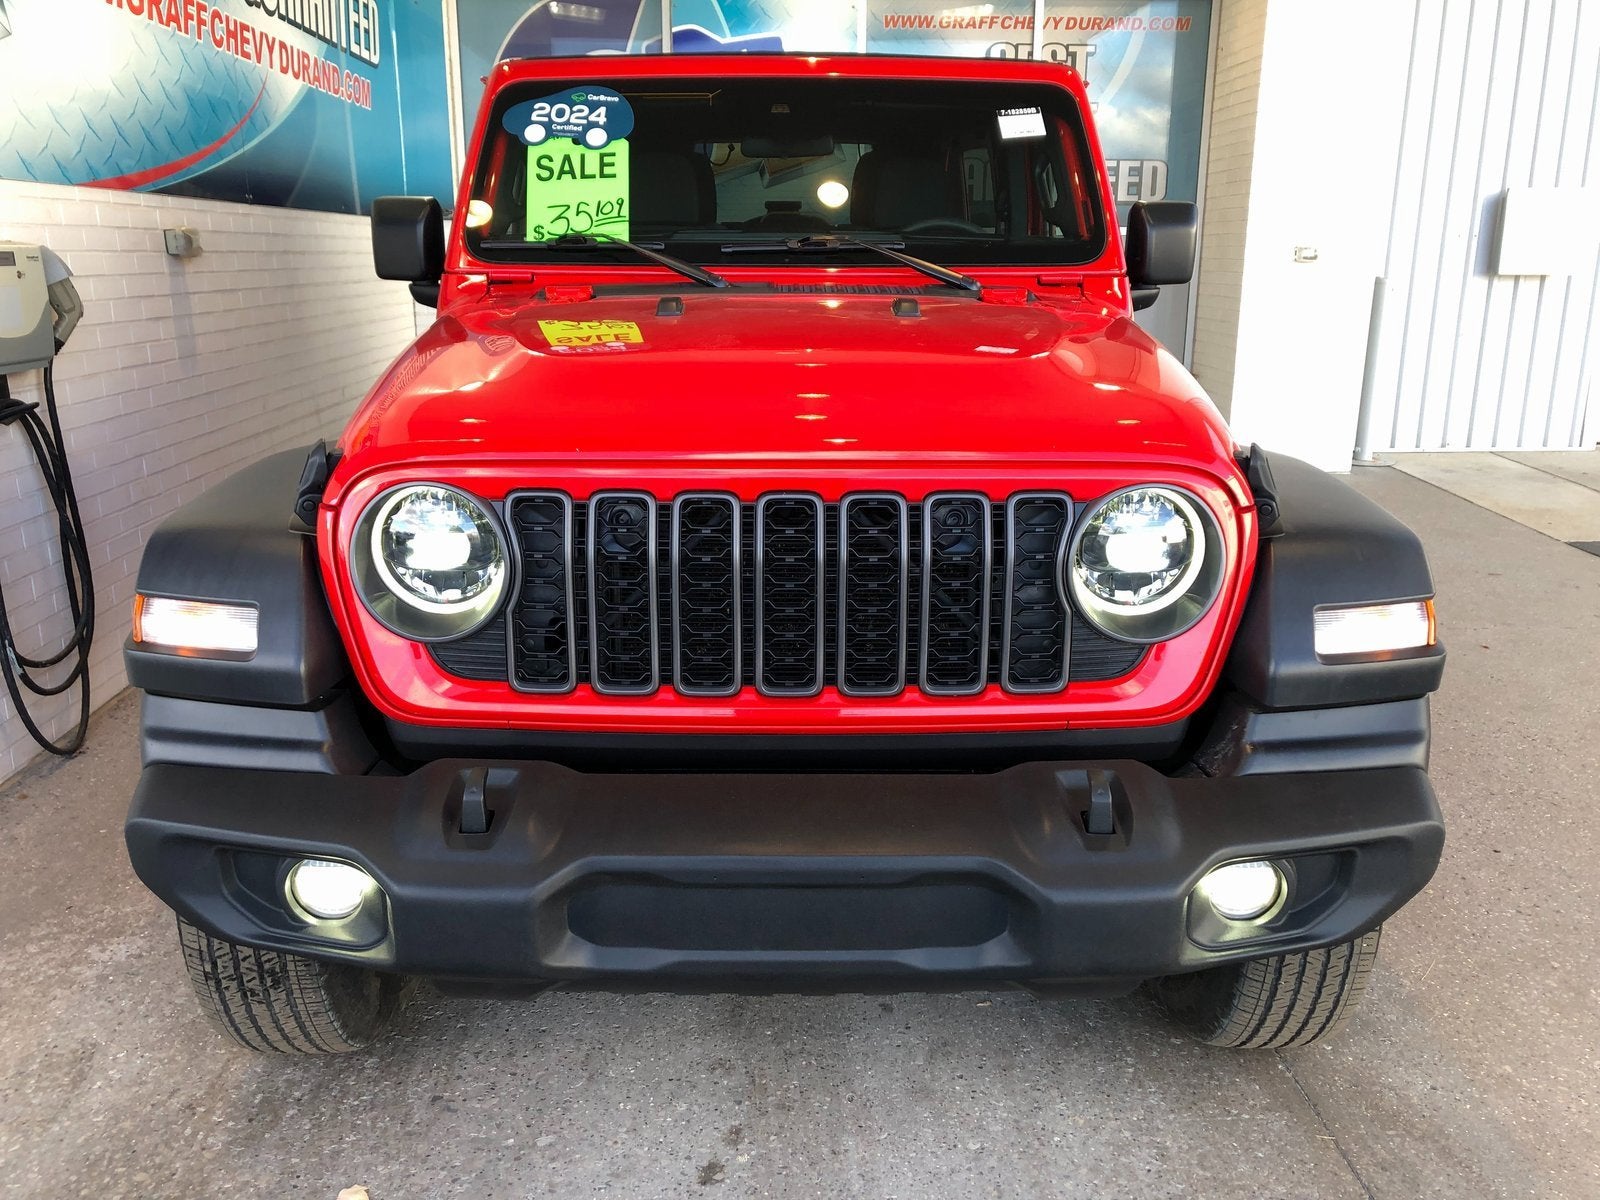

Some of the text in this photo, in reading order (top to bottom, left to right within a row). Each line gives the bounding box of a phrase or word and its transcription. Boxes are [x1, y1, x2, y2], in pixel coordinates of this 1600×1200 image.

[587, 93, 619, 102] CarBravo
[531, 102, 607, 125] 2024
[551, 123, 582, 131] Certified
[535, 152, 617, 182] SALE
